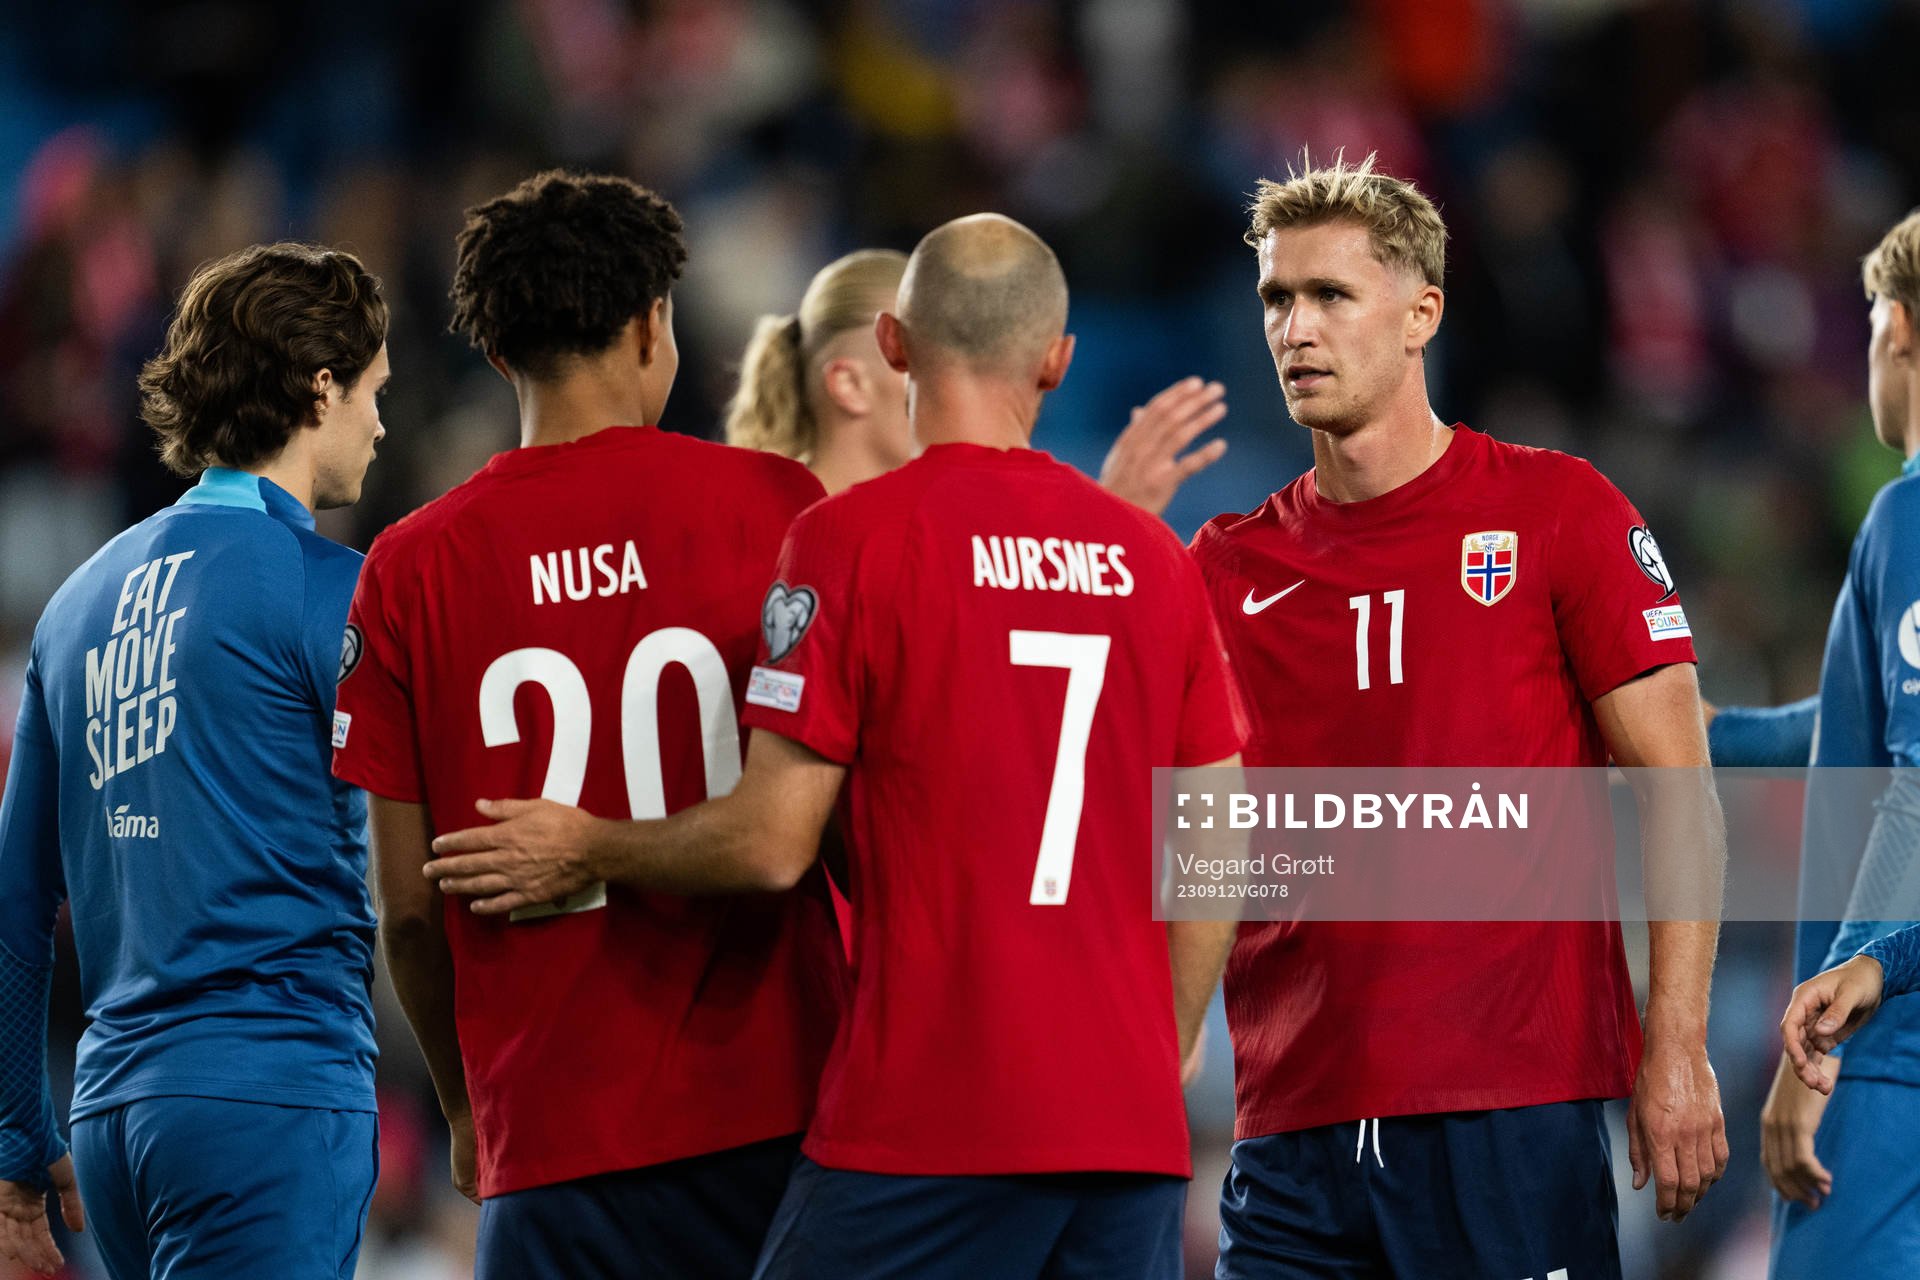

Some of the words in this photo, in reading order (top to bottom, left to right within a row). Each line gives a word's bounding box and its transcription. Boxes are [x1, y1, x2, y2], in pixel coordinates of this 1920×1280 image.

[111, 550, 196, 636] EAT
[530, 540, 648, 605] NUSA
[972, 535, 1134, 597] AURSNES
[1646, 609, 1663, 618] UEFA
[85, 606, 187, 719] MOVE
[1349, 589, 1405, 691] 11
[86, 687, 177, 790] SLEEP
[479, 627, 742, 921] 20
[1009, 630, 1111, 905] 7
